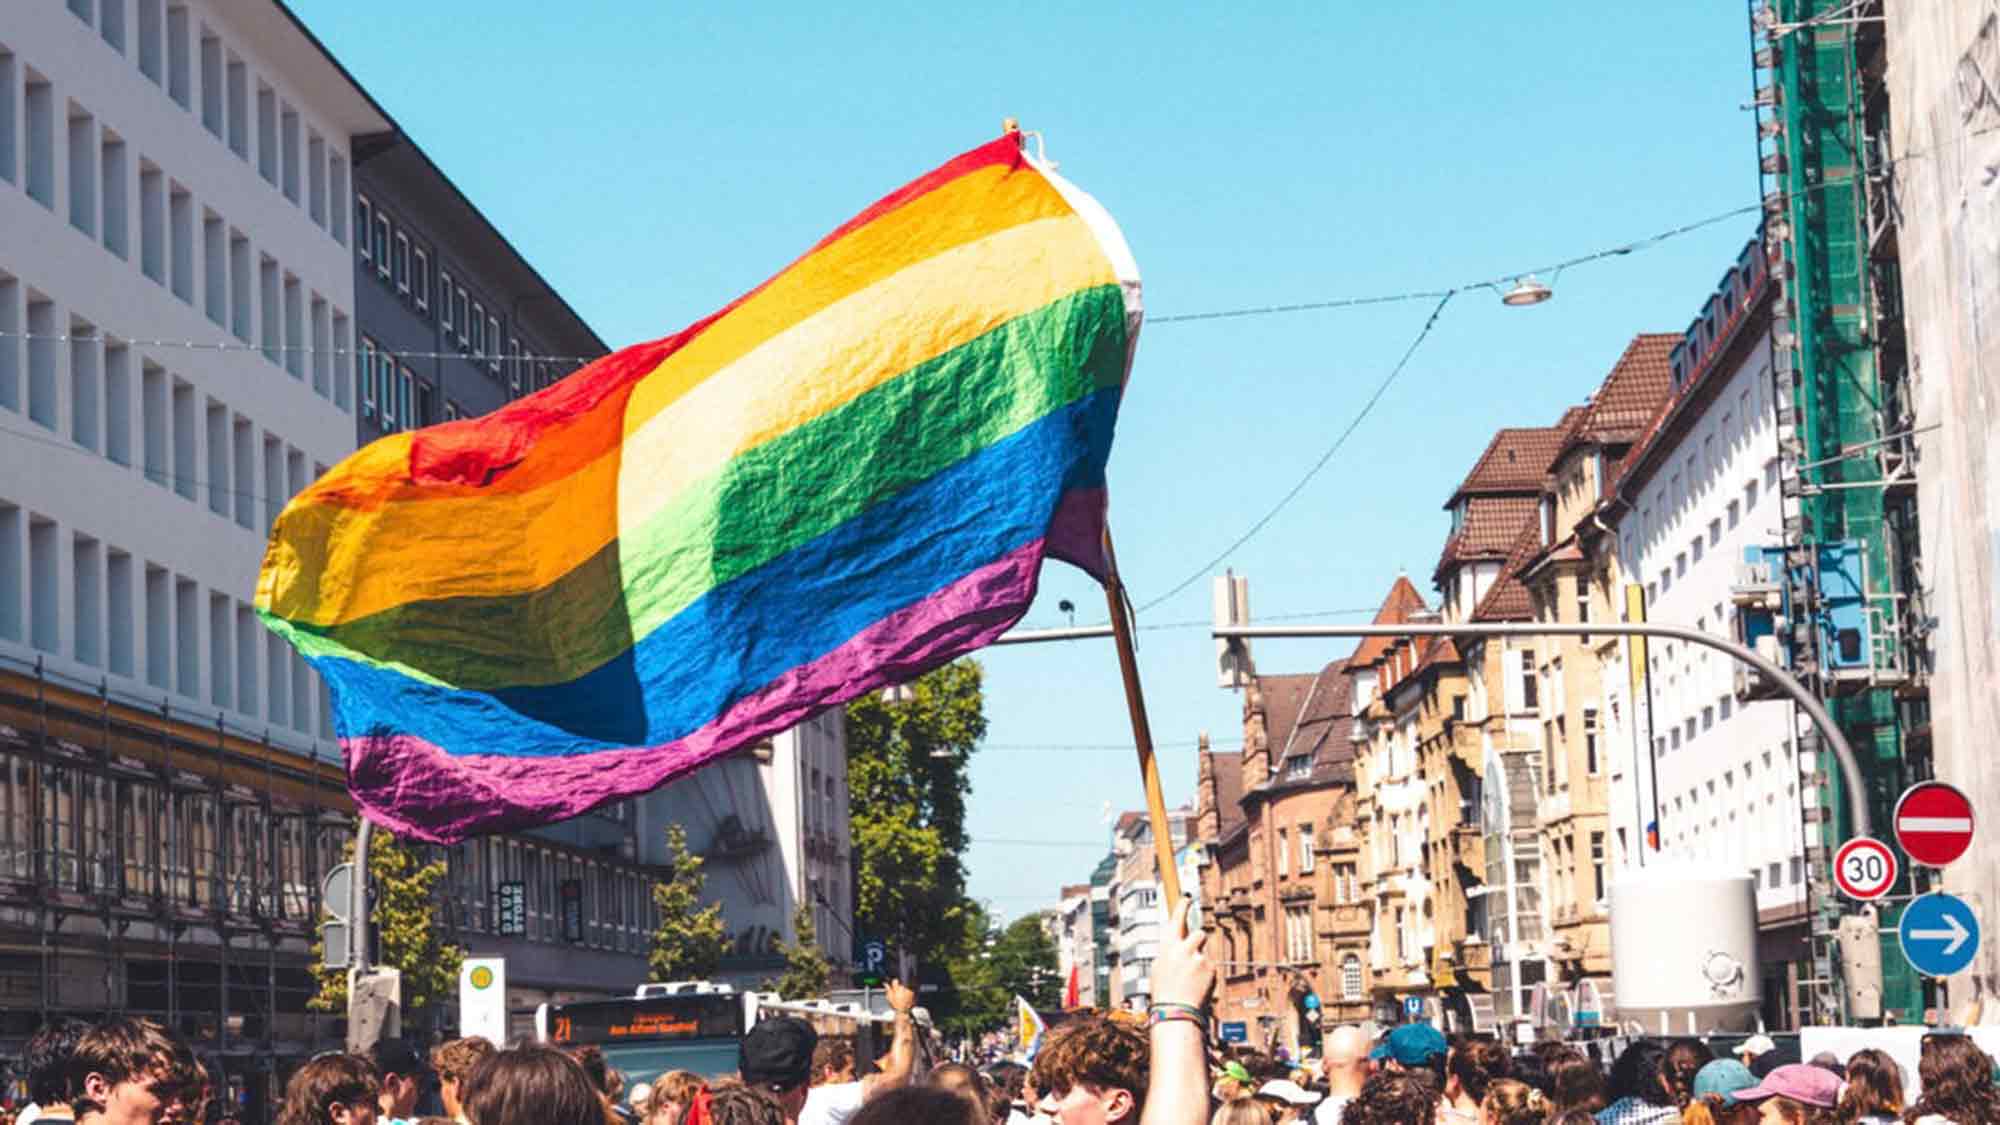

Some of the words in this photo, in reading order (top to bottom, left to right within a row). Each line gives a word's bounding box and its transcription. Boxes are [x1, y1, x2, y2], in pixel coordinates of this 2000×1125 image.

[1848, 856, 1882, 882] 30
[1408, 998, 1420, 1014] U
[554, 1017, 571, 1041] 21
